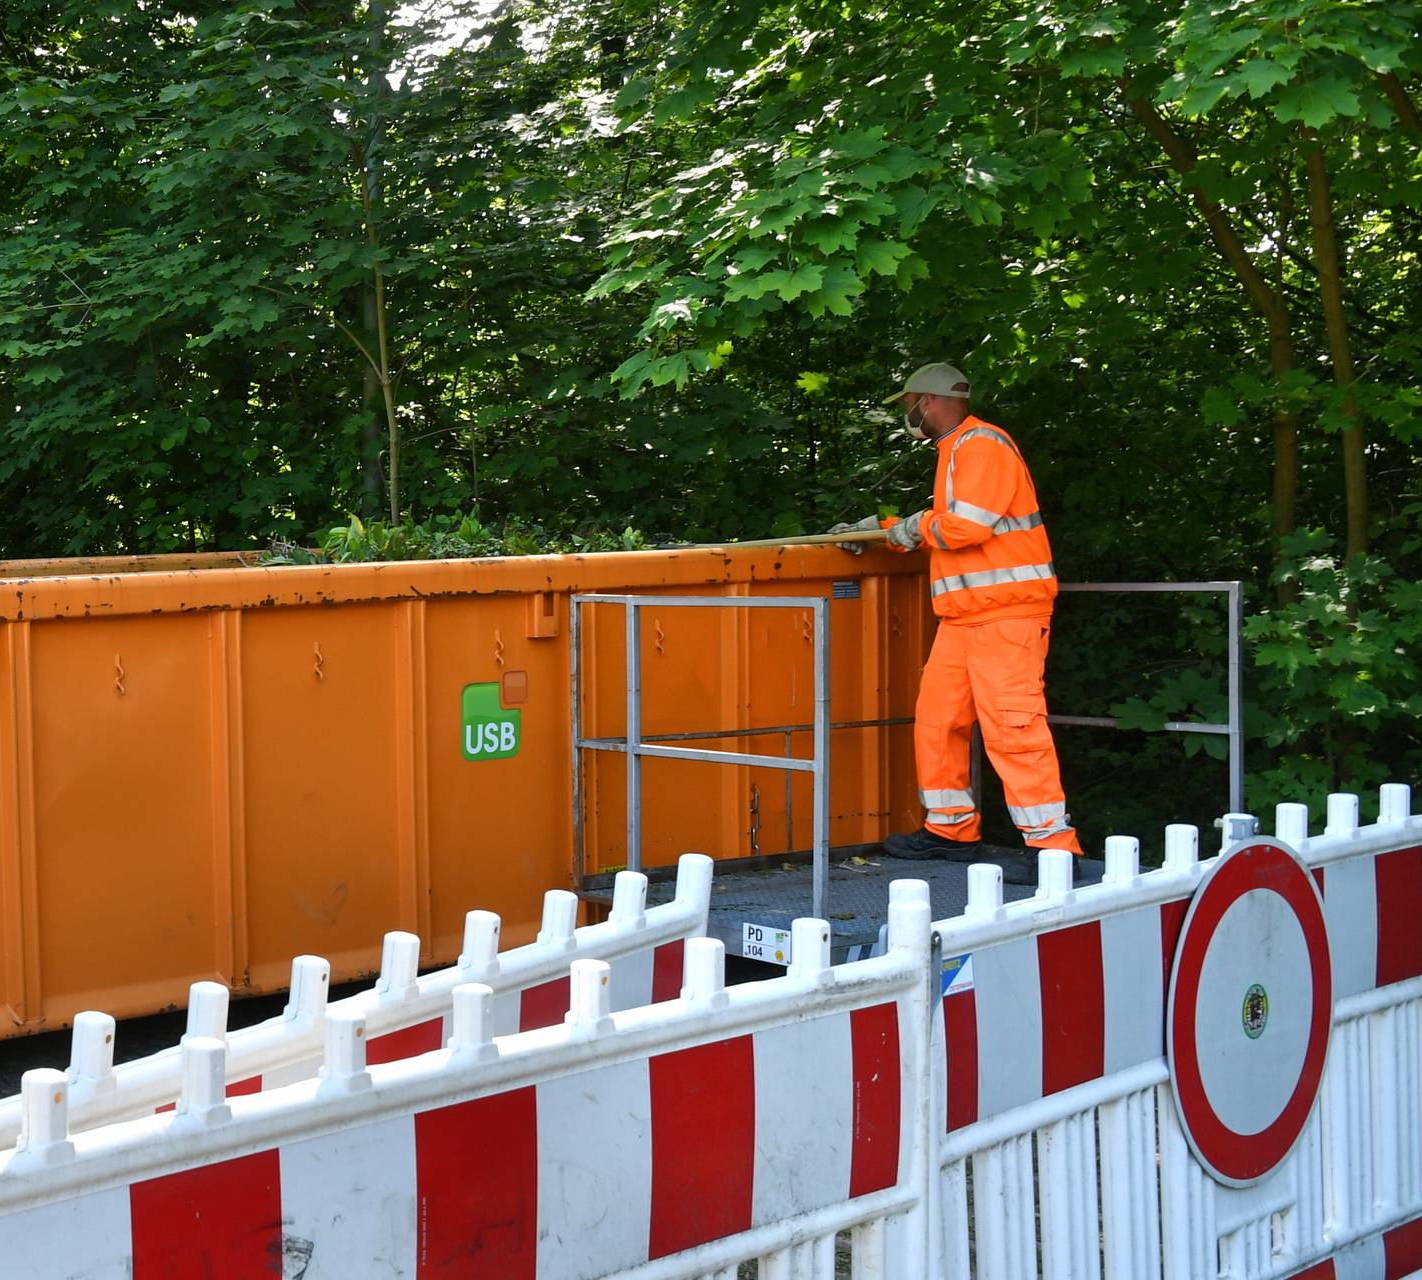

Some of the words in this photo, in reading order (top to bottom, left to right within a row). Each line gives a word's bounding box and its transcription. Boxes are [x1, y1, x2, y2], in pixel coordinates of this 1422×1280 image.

[466, 721, 516, 755] USB
[748, 925, 763, 942] PD
[747, 944, 763, 957] 104
